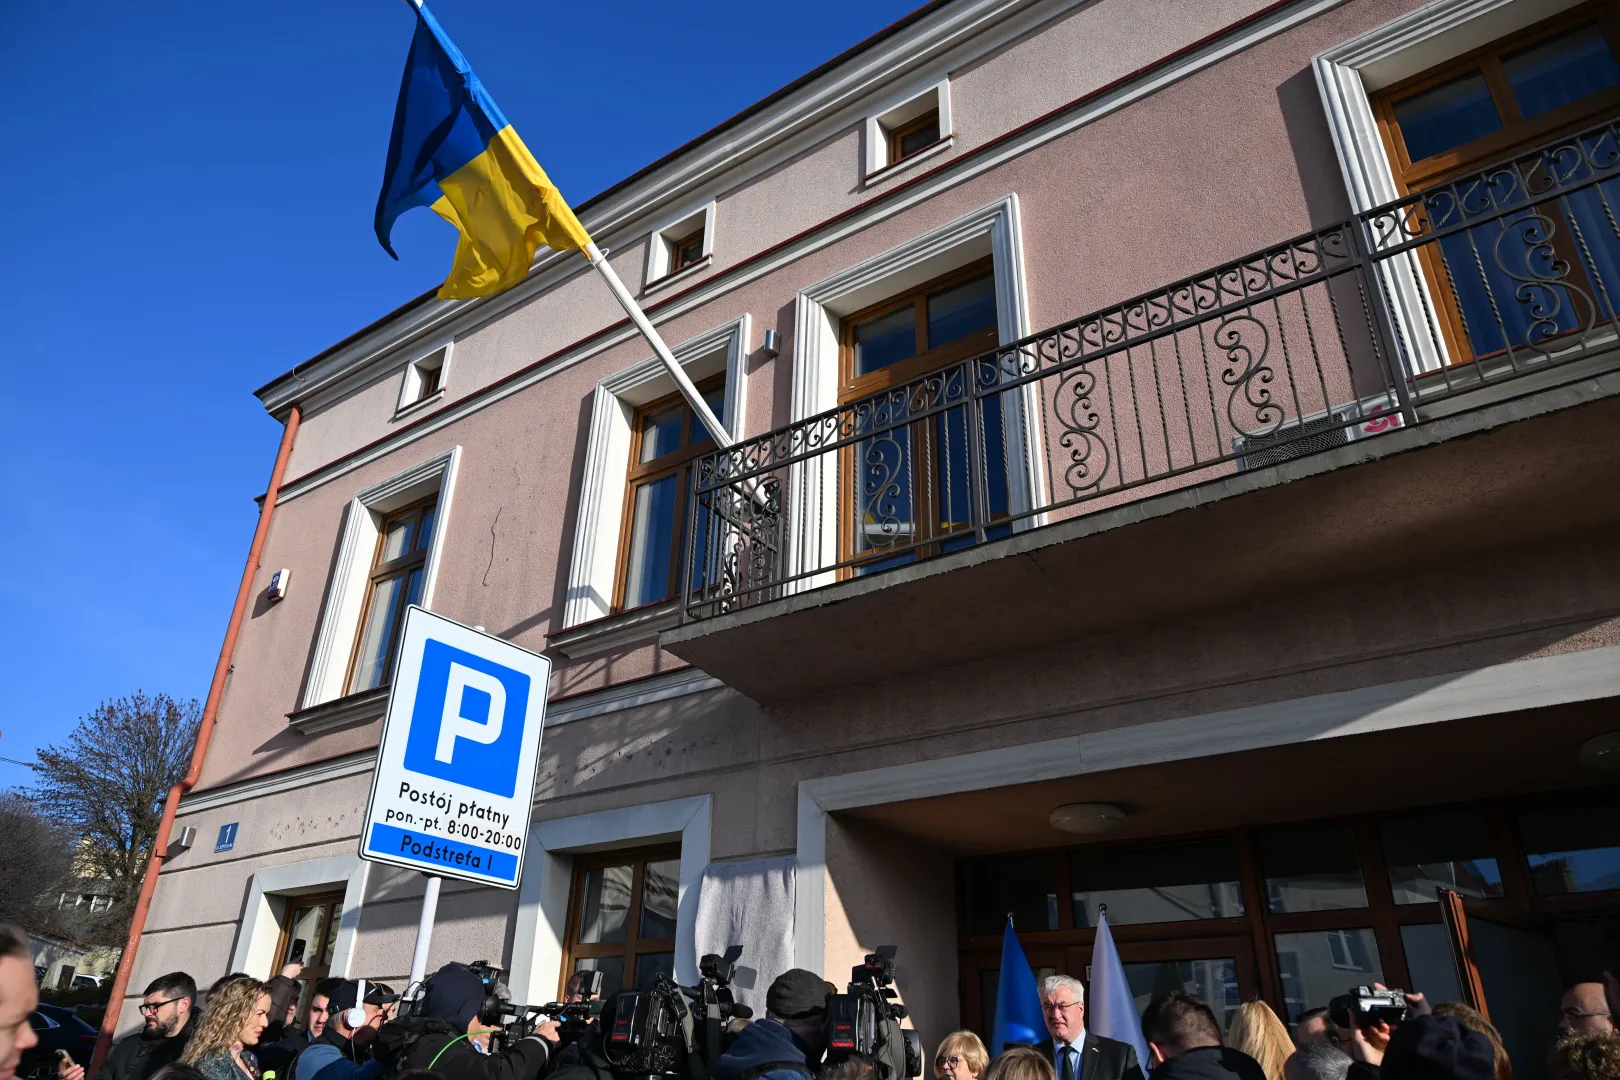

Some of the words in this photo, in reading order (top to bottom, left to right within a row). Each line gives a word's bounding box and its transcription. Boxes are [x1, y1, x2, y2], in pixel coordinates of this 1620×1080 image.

[435, 661, 507, 764] P
[399, 782, 452, 815] Postój
[457, 800, 510, 830] płatny
[226, 825, 232, 843] 1
[386, 808, 442, 831] pon.-pt.
[447, 820, 521, 850] 8:00-20:00
[401, 834, 481, 868] Podstrefa
